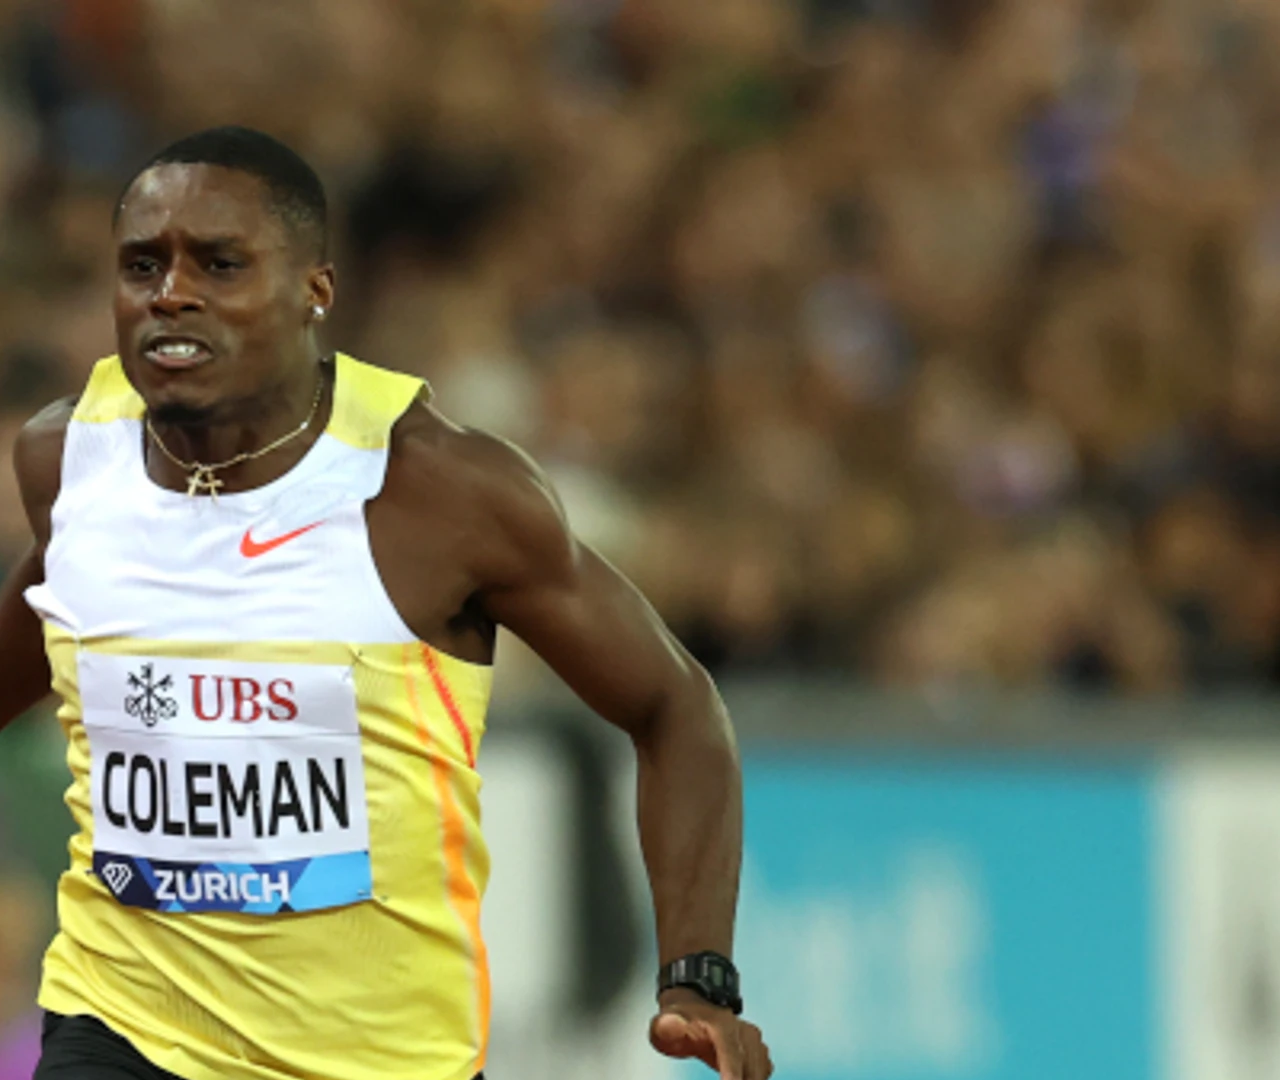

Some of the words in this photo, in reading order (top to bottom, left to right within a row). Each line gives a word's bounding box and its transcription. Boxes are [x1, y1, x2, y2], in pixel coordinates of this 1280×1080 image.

[189, 674, 300, 723] UBS
[102, 751, 350, 838] COLEMAN
[153, 869, 291, 903] ZURICH
